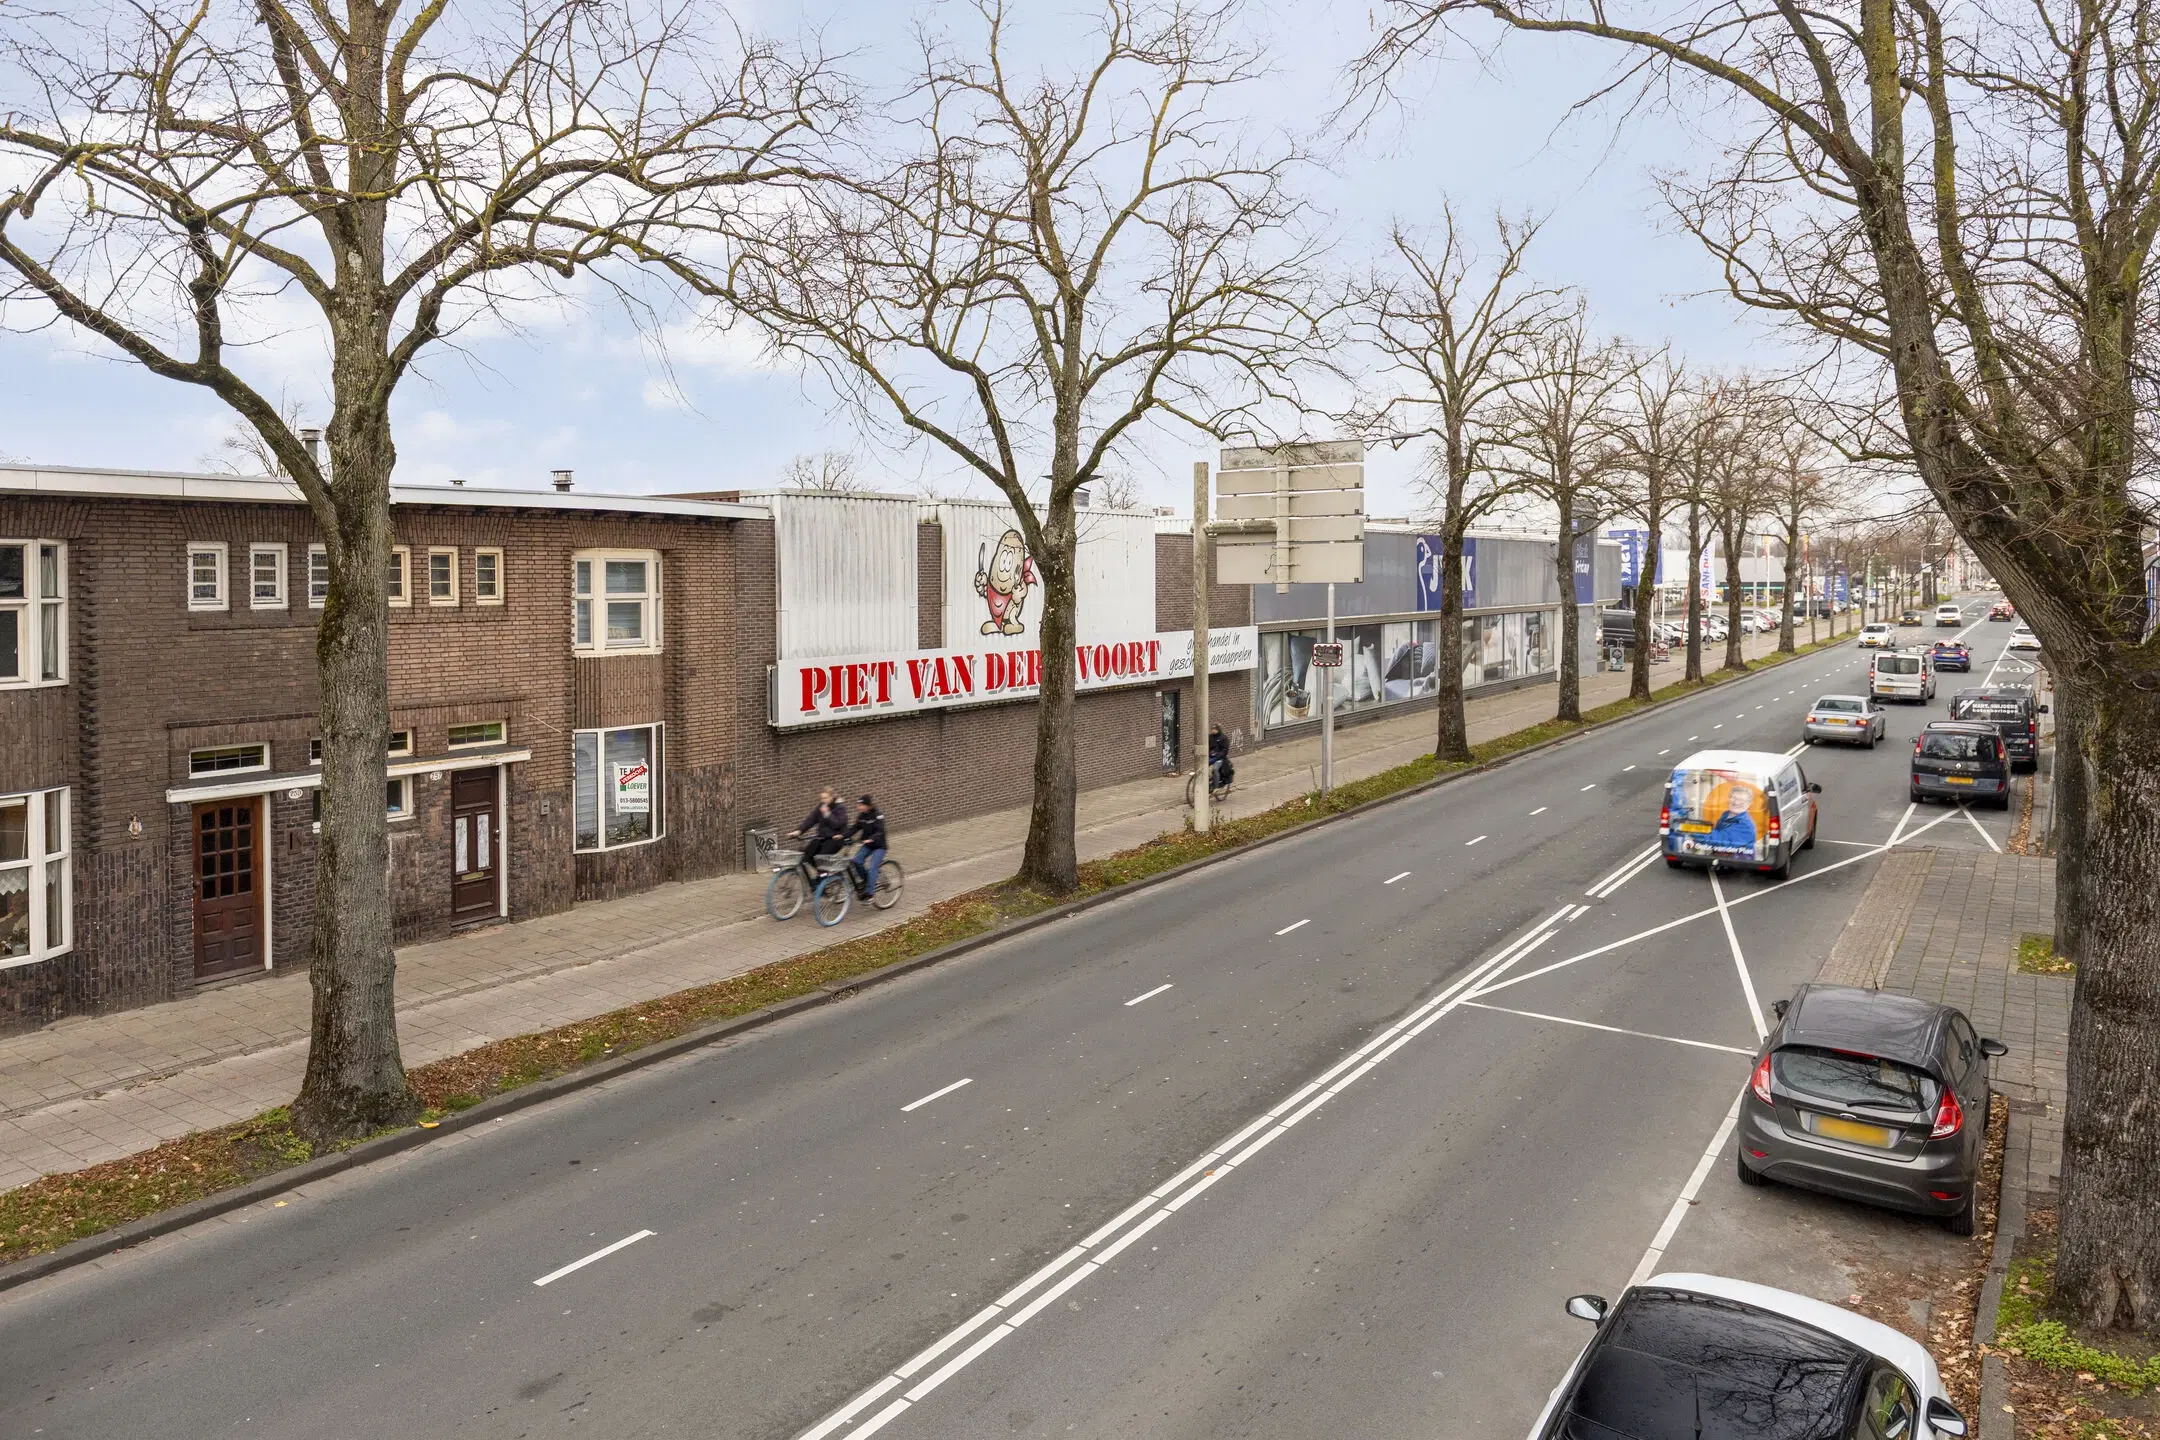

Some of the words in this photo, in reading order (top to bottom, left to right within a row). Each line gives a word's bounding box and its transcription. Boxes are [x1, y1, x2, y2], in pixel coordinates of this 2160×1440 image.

[1233, 632, 1240, 645] in
[1211, 647, 1252, 668] aardappelen
[800, 661, 896, 713] PIET
[906, 654, 974, 700] VAN
[1076, 640, 1161, 681] VOORT
[620, 768, 627, 776] TE
